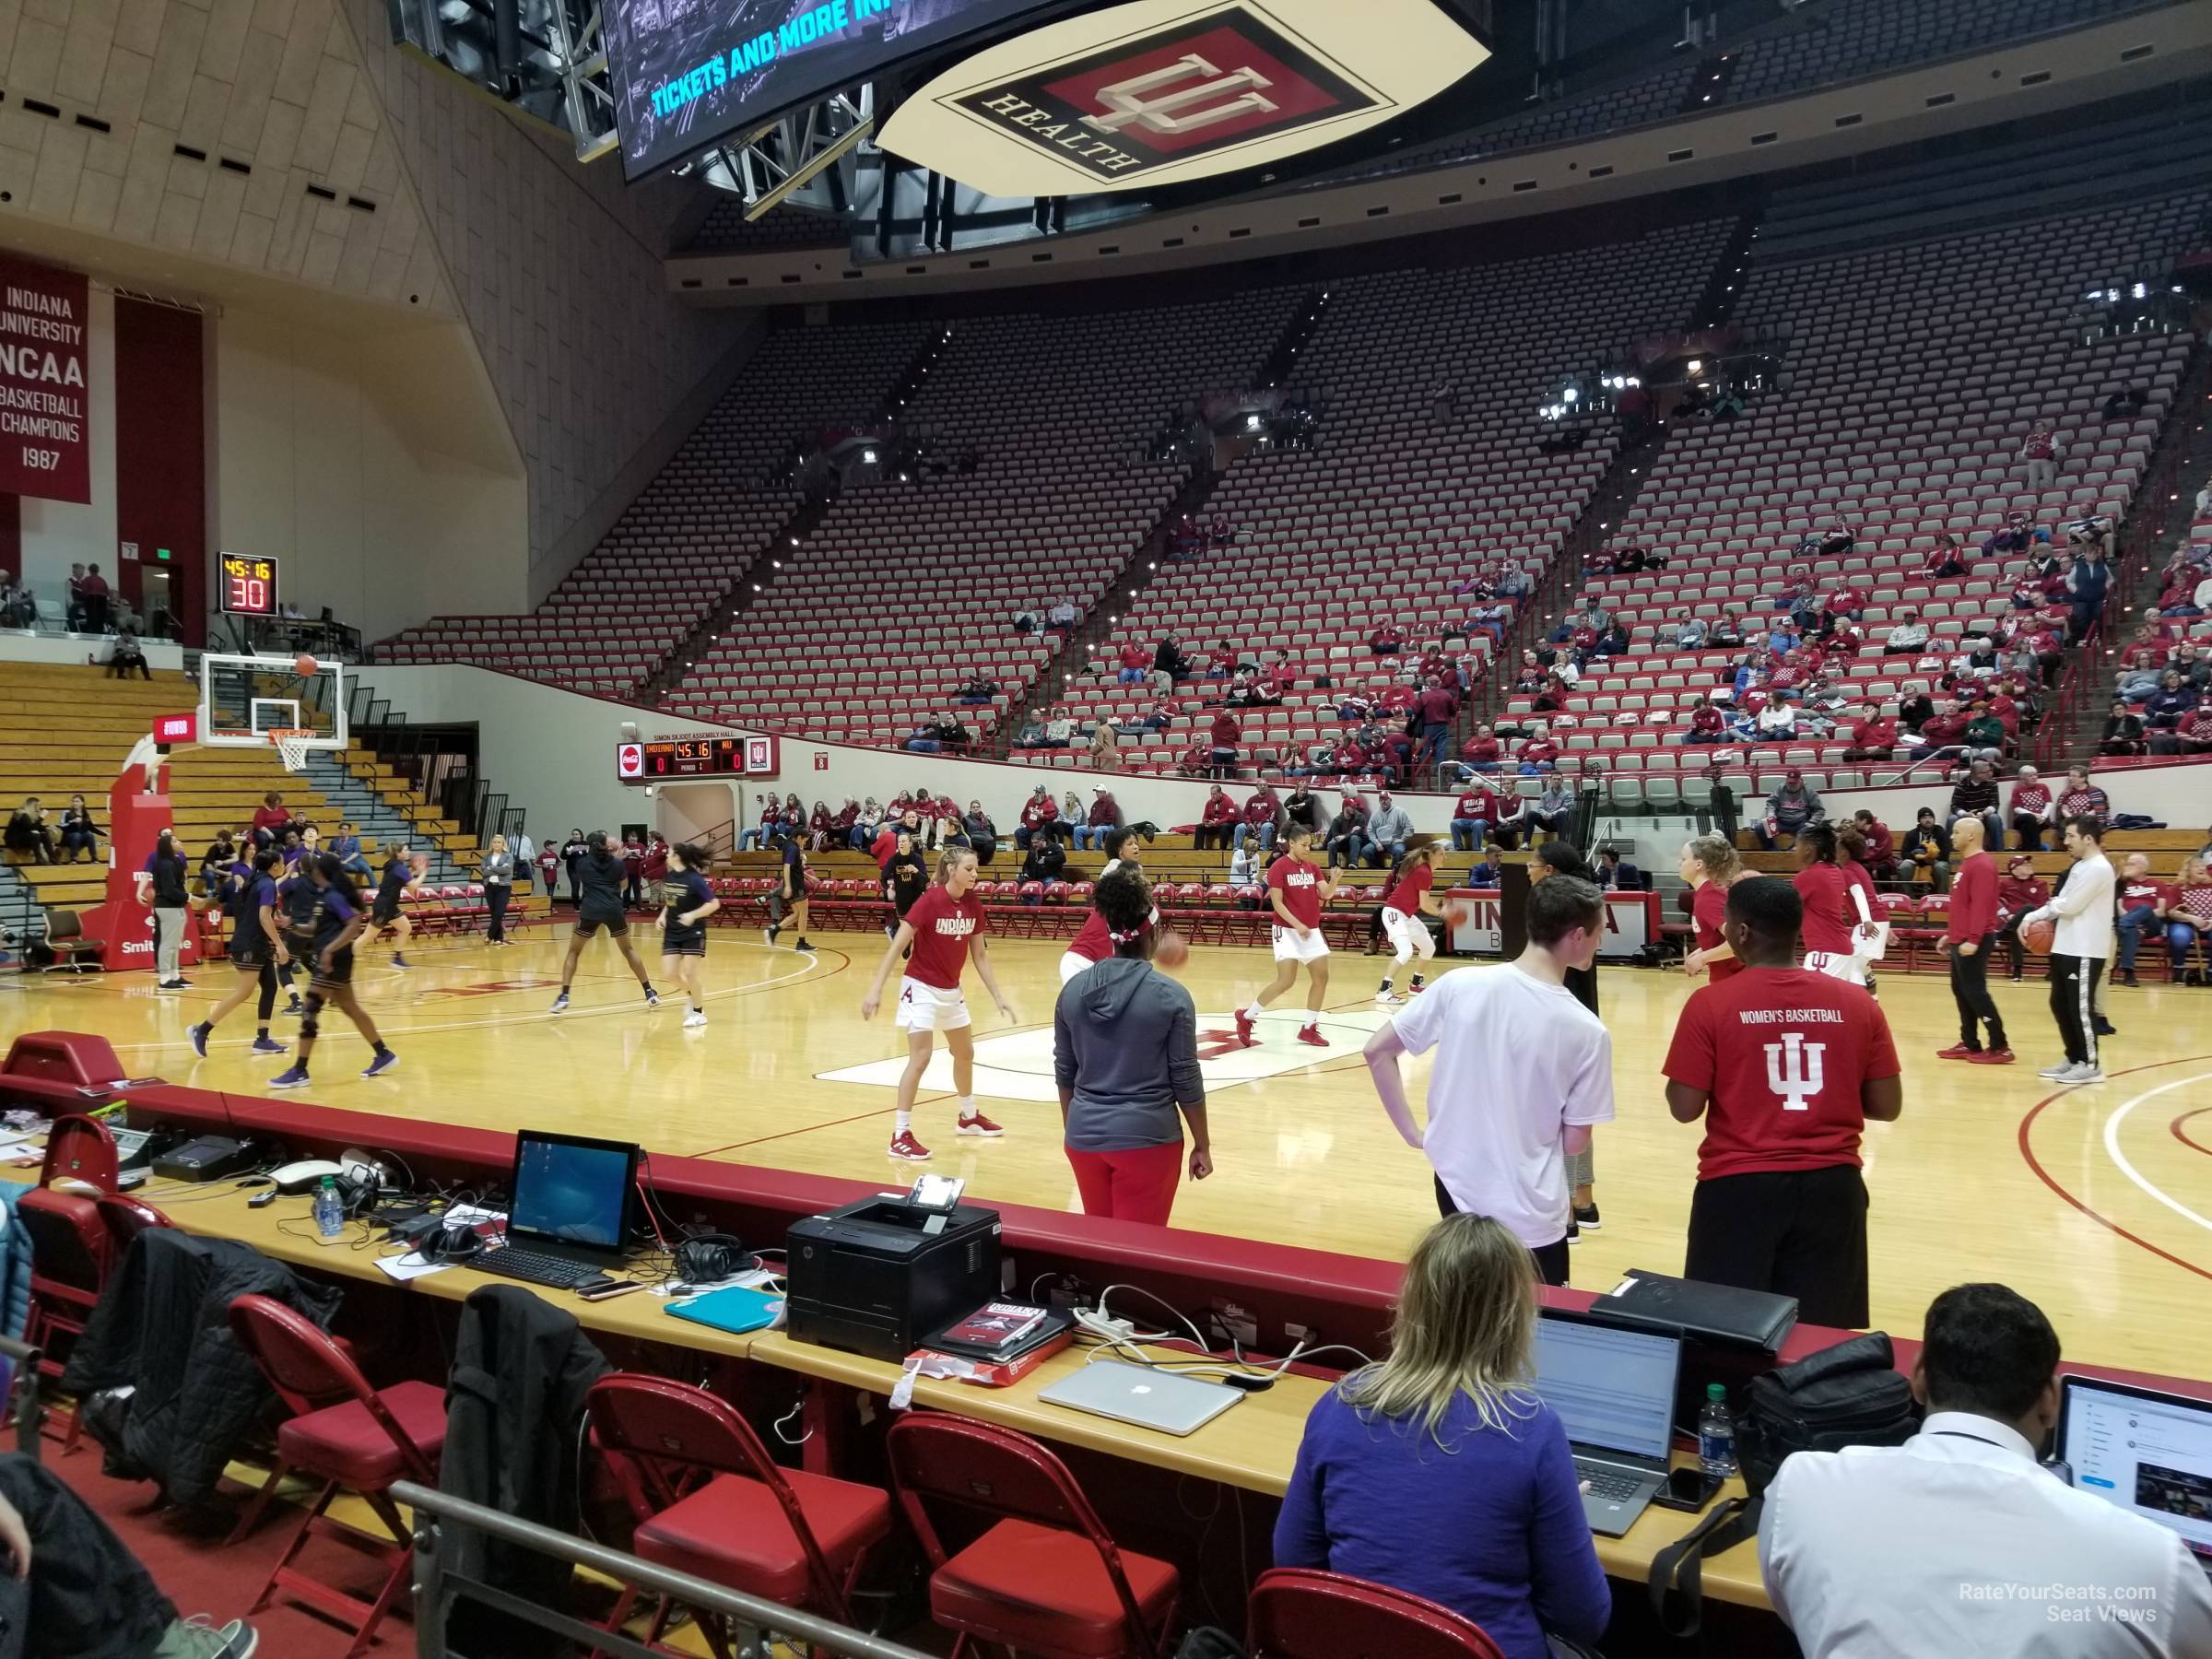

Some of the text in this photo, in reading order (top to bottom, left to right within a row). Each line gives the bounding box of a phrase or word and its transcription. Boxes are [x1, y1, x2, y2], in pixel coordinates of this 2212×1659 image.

[651, 54, 726, 119] TICKETS
[730, 30, 775, 79] AND
[778, 0, 848, 54] MORE
[981, 92, 1142, 171] HEALTH
[7, 287, 73, 319] INDIANA
[0, 342, 85, 388] NCAA
[0, 385, 82, 418] BASKETBALL
[1, 412, 80, 443] CHAMPIONS
[23, 446, 61, 471] 1987
[224, 560, 271, 580] 45:16
[231, 578, 265, 608] 30
[646, 744, 675, 753] INDIANA
[678, 743, 709, 758] 45:16
[722, 741, 733, 749] NU
[657, 757, 665, 772] 0
[733, 754, 741, 769] 0
[818, 758, 824, 769] 8
[1739, 1008, 1844, 1024] WOMEN'S BASKETBALL
[991, 1302, 1041, 1315] INDIANA
